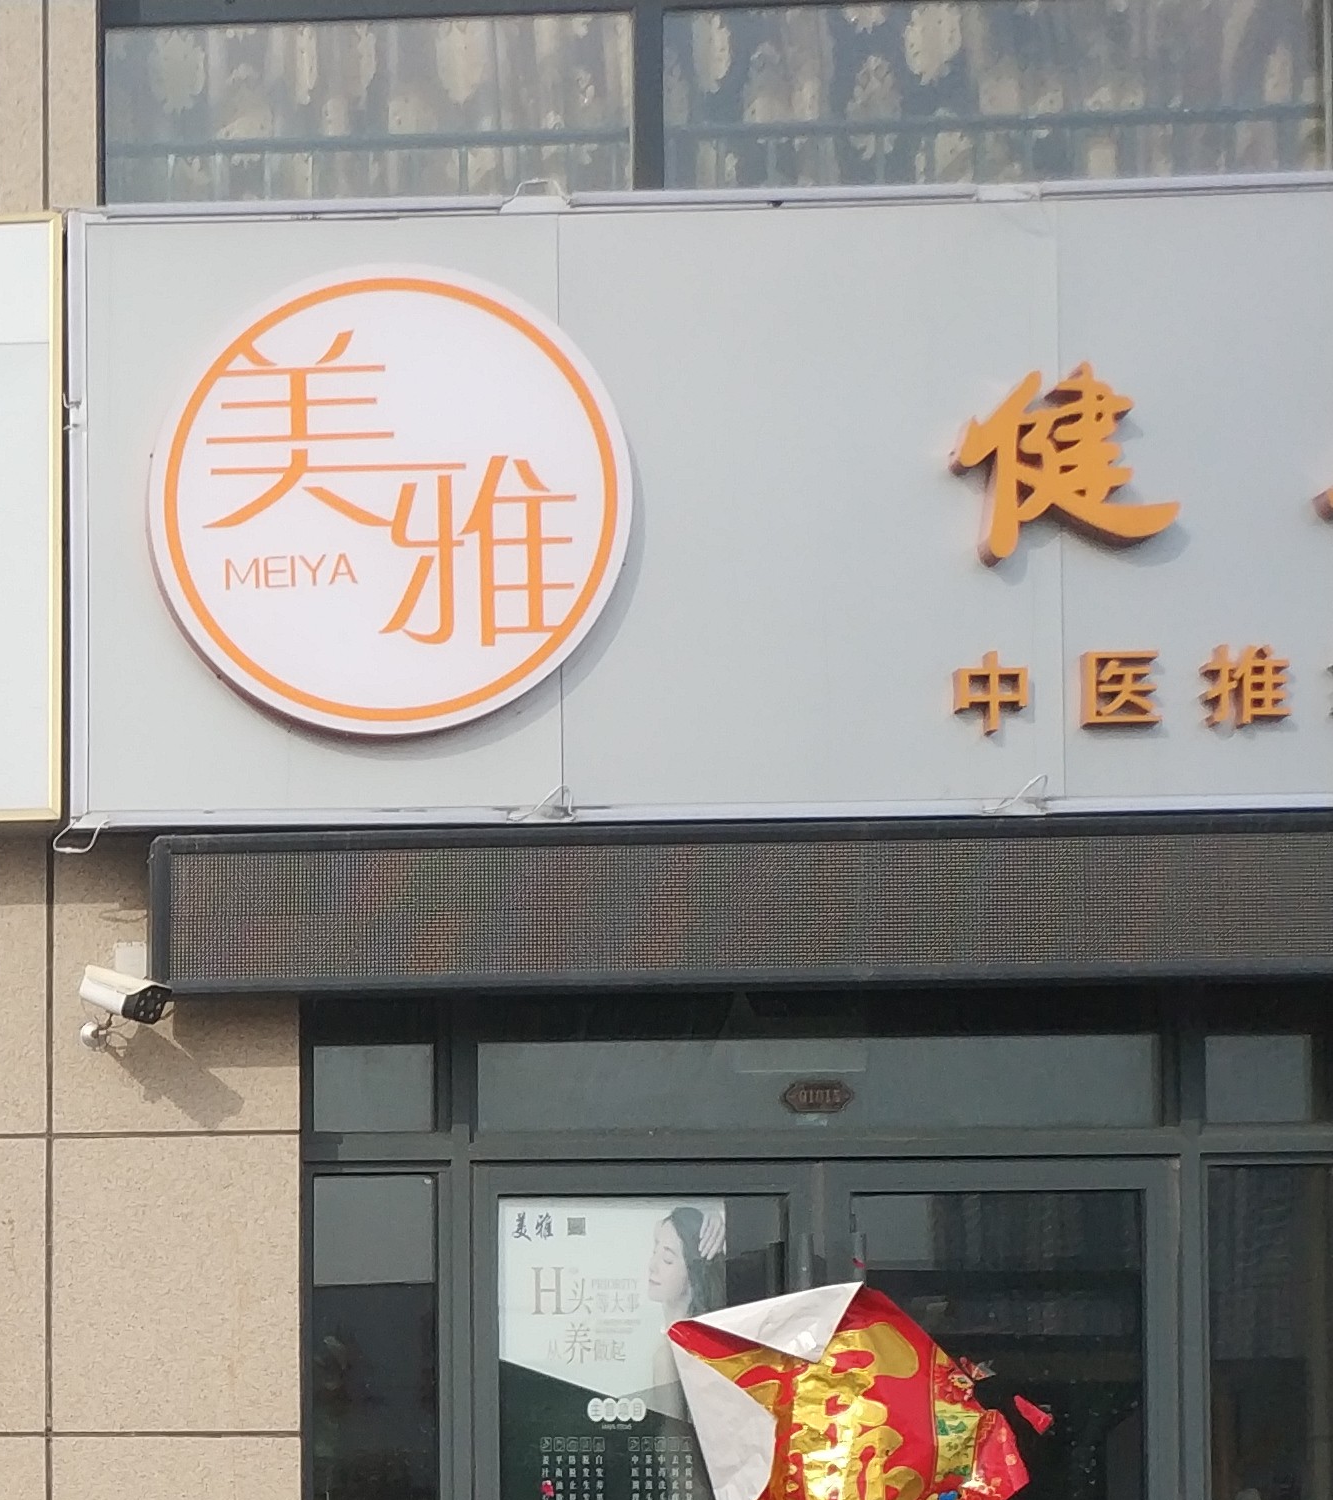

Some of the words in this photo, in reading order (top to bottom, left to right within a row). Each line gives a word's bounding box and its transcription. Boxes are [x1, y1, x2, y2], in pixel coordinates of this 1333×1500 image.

[201, 329, 578, 647] 美雅
[224, 552, 359, 590] MEIYA
[952, 643, 1333, 737] 中医推
[513, 1211, 555, 1242] 美雅
